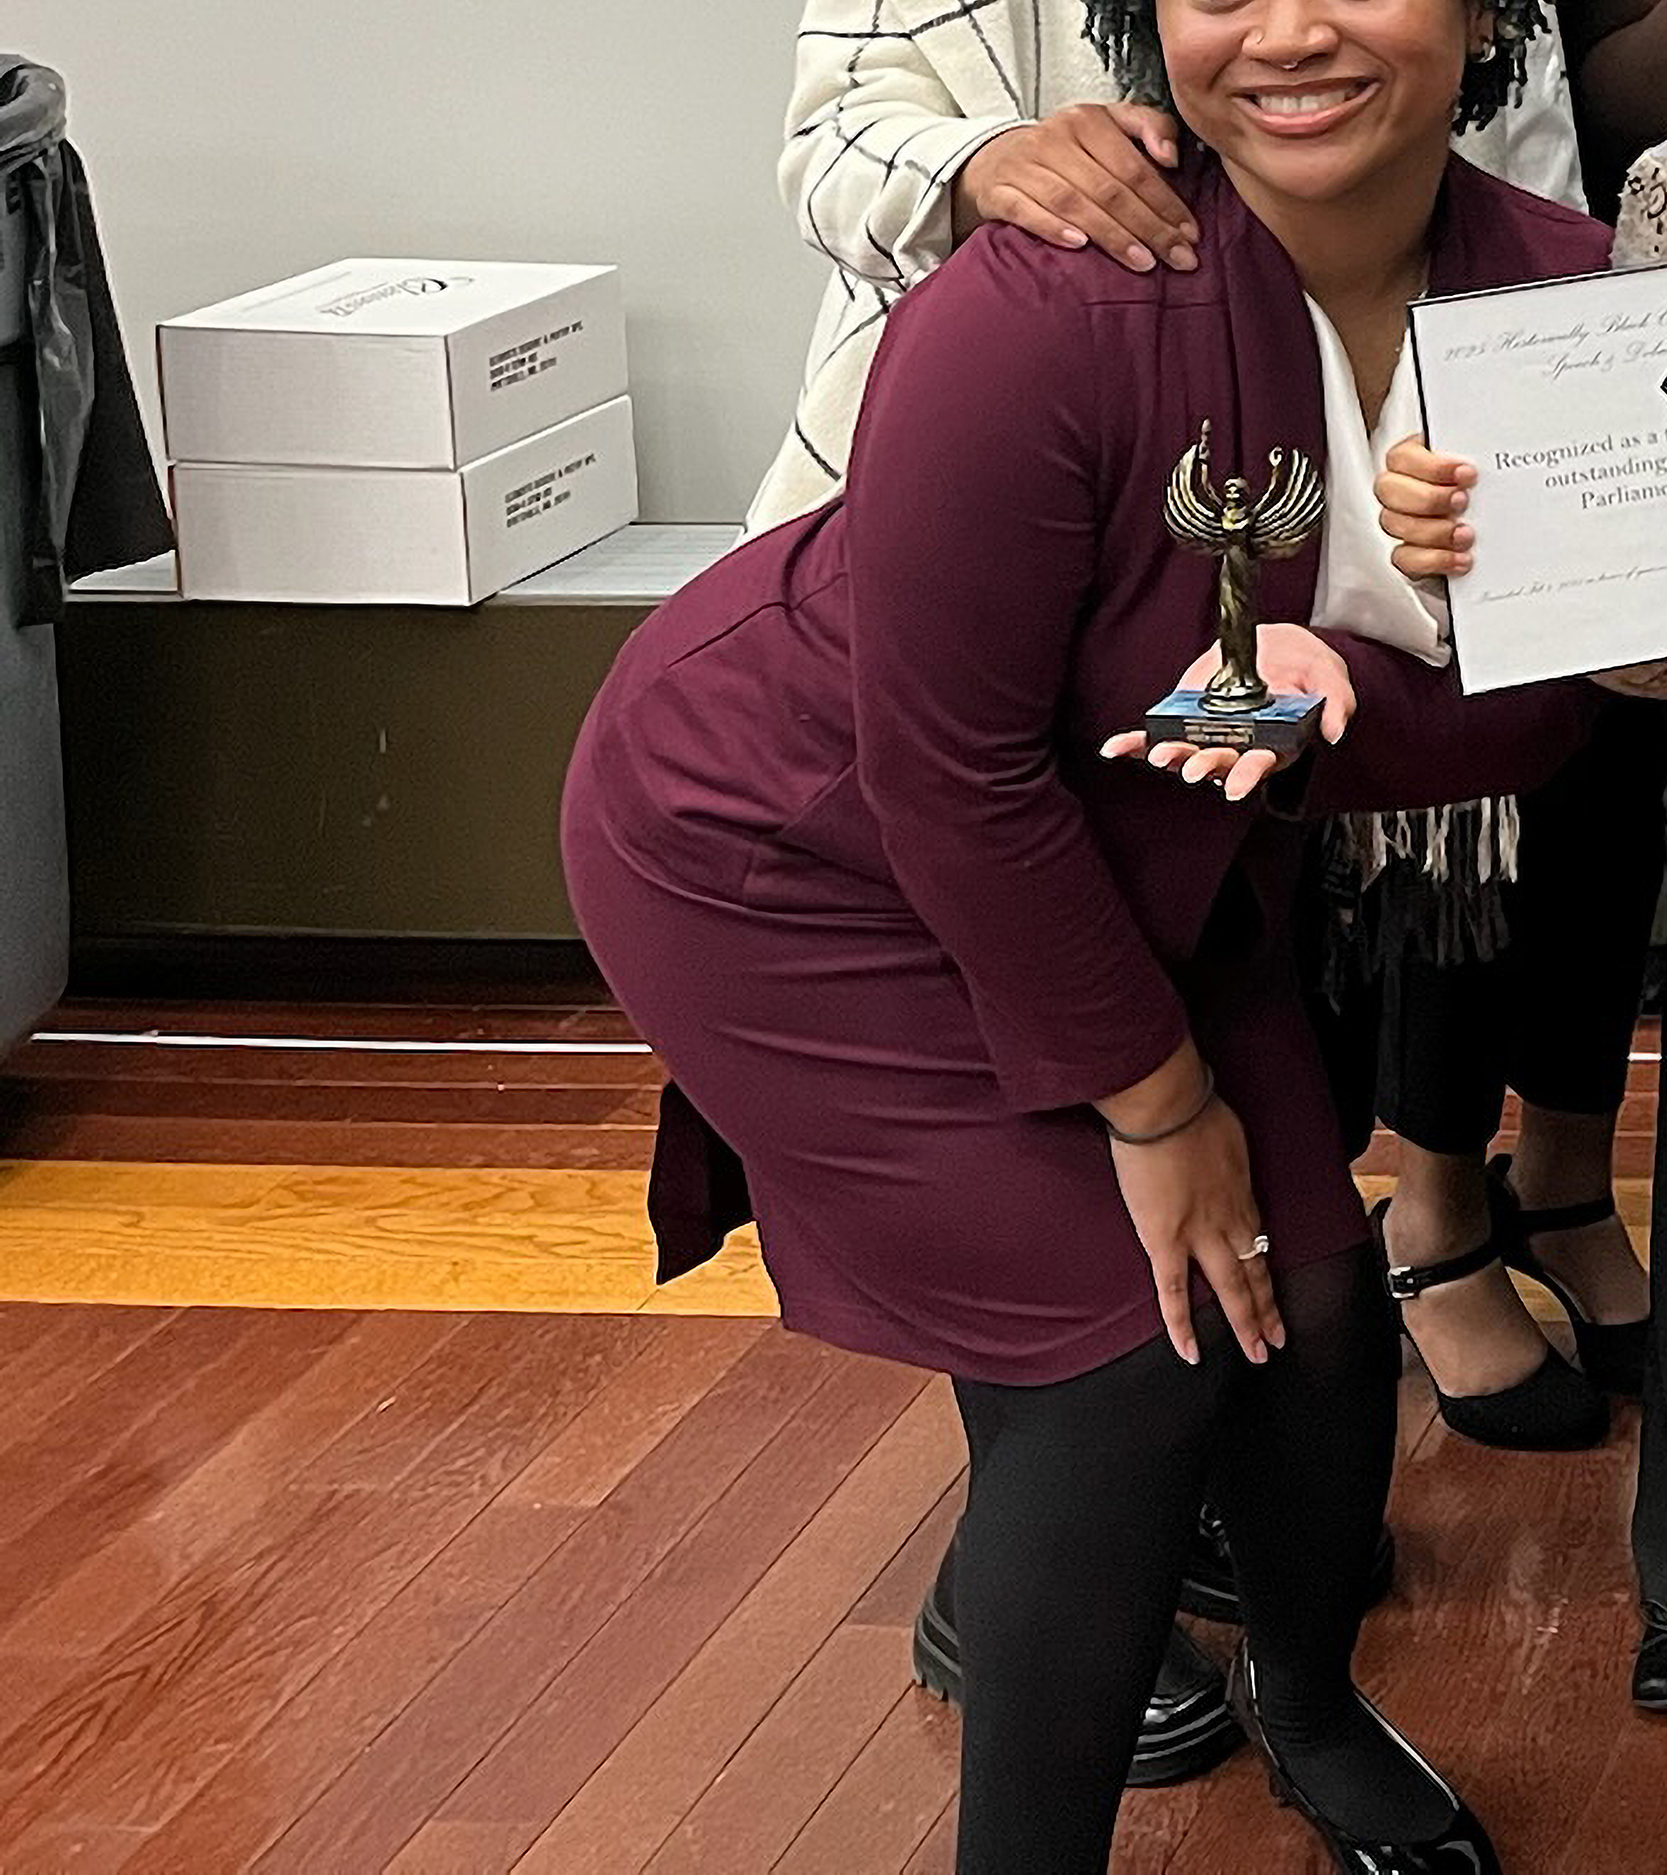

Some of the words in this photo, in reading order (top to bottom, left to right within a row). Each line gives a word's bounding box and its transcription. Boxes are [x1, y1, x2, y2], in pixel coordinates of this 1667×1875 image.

[1495, 435, 1614, 471] Recognized
[1619, 434, 1642, 450] as
[1647, 431, 1660, 445] a
